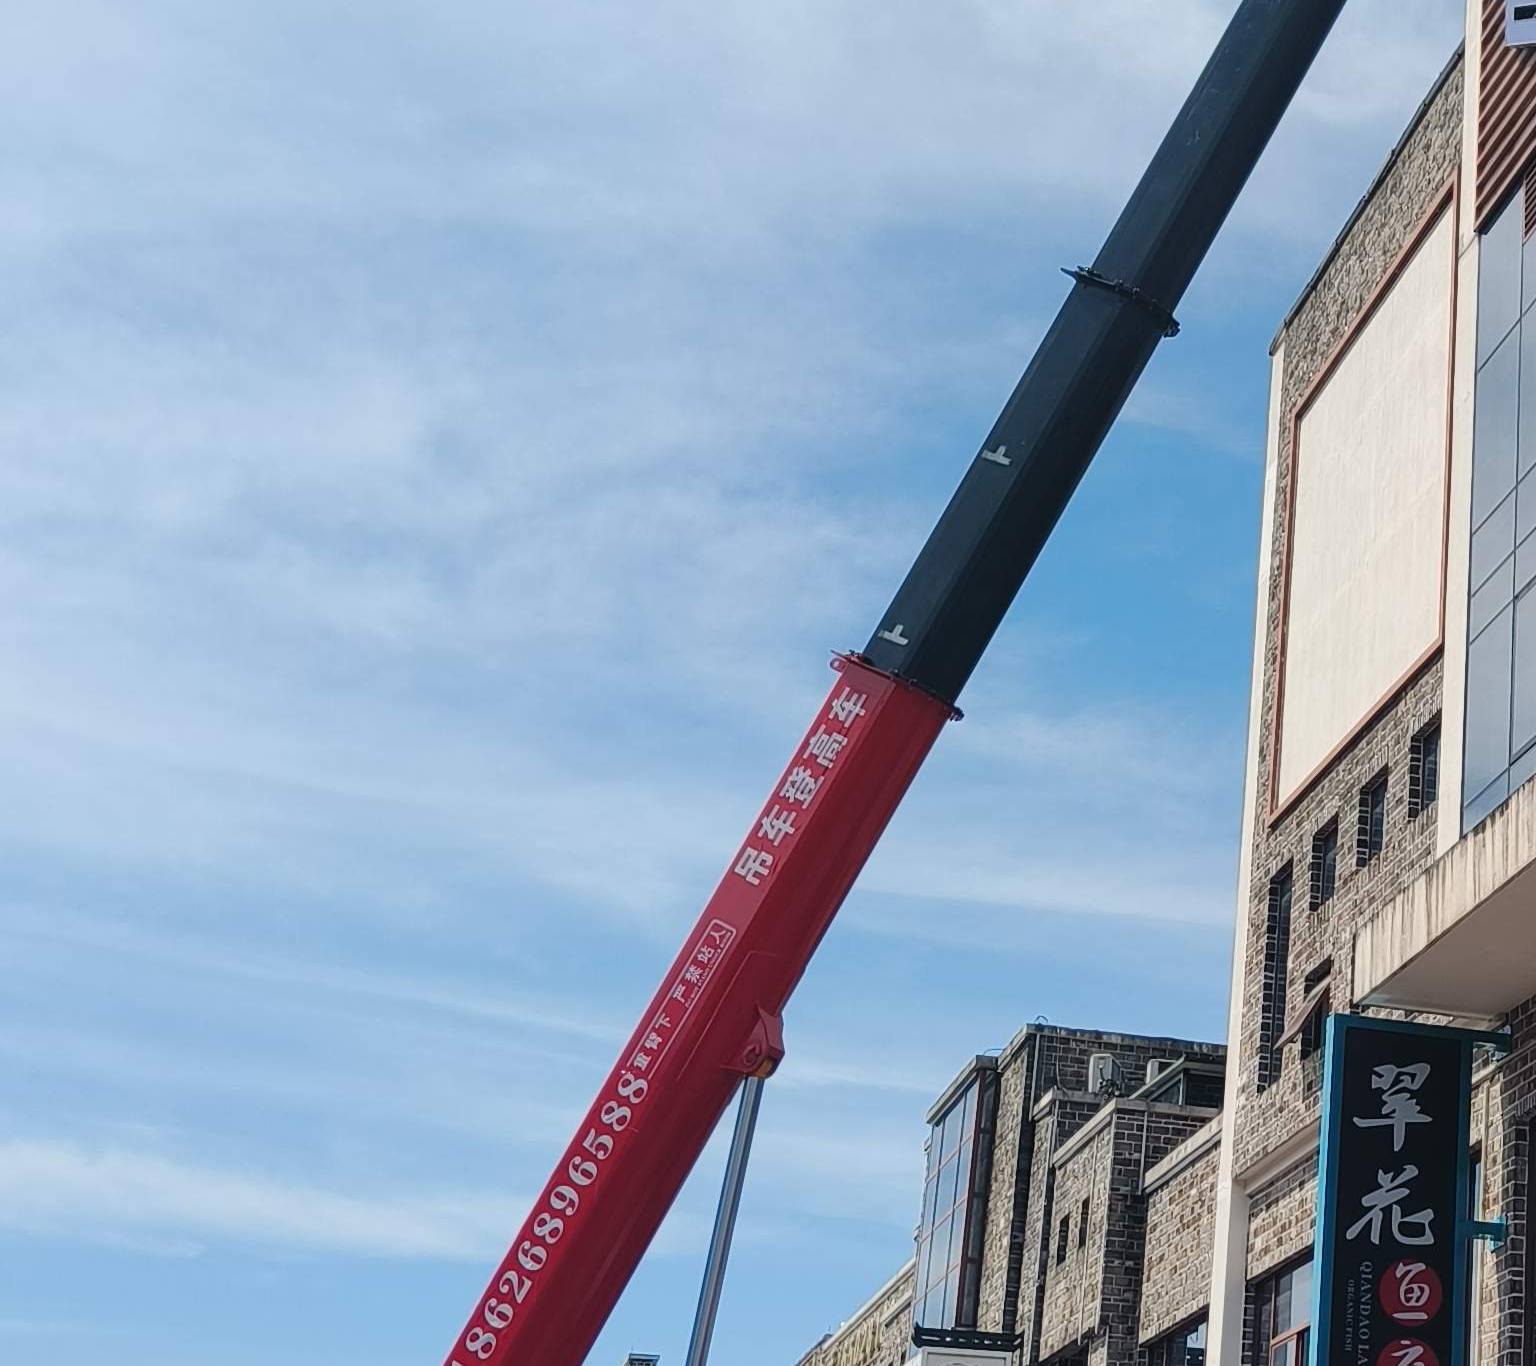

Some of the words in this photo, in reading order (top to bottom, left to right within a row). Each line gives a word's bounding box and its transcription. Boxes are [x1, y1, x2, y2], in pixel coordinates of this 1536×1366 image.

[733, 688, 870, 887] 吊车登高车
[1359, 1261, 1373, 1339] QIANDAO
